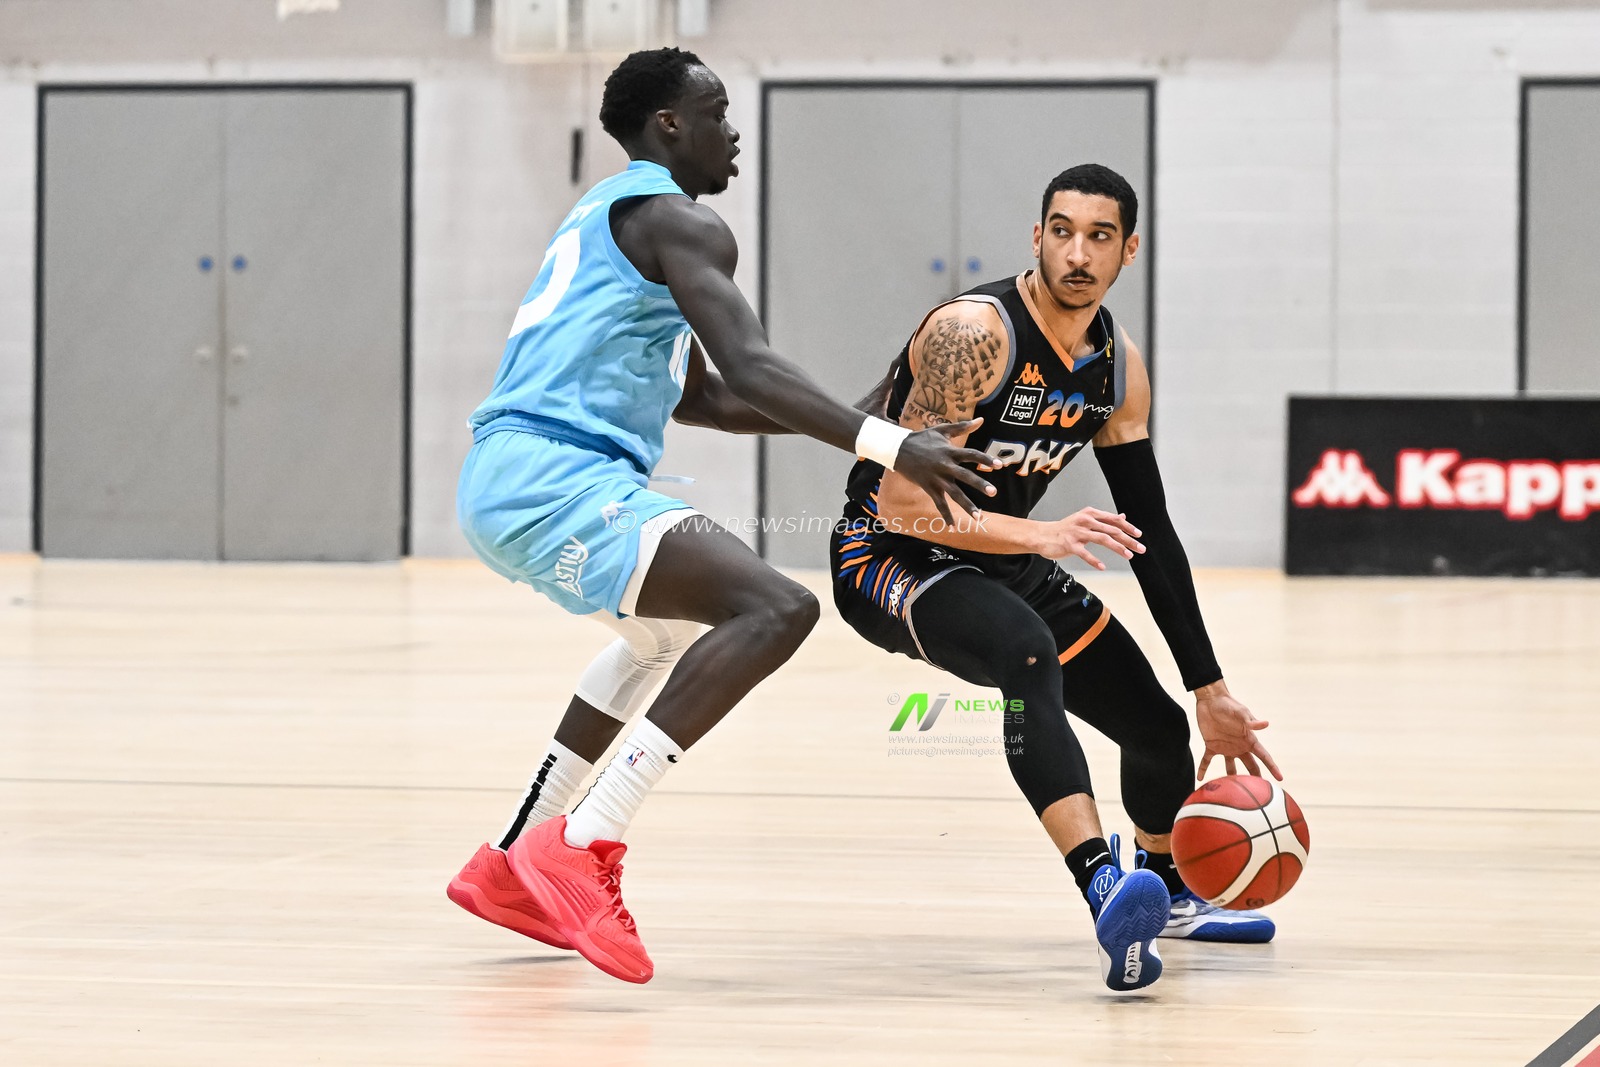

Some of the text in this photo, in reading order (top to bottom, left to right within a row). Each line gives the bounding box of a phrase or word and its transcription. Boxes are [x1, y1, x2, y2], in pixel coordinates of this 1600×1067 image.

[1009, 407, 1033, 420] Legal
[1037, 389, 1085, 428] 20
[1397, 449, 1600, 521] Kapp
